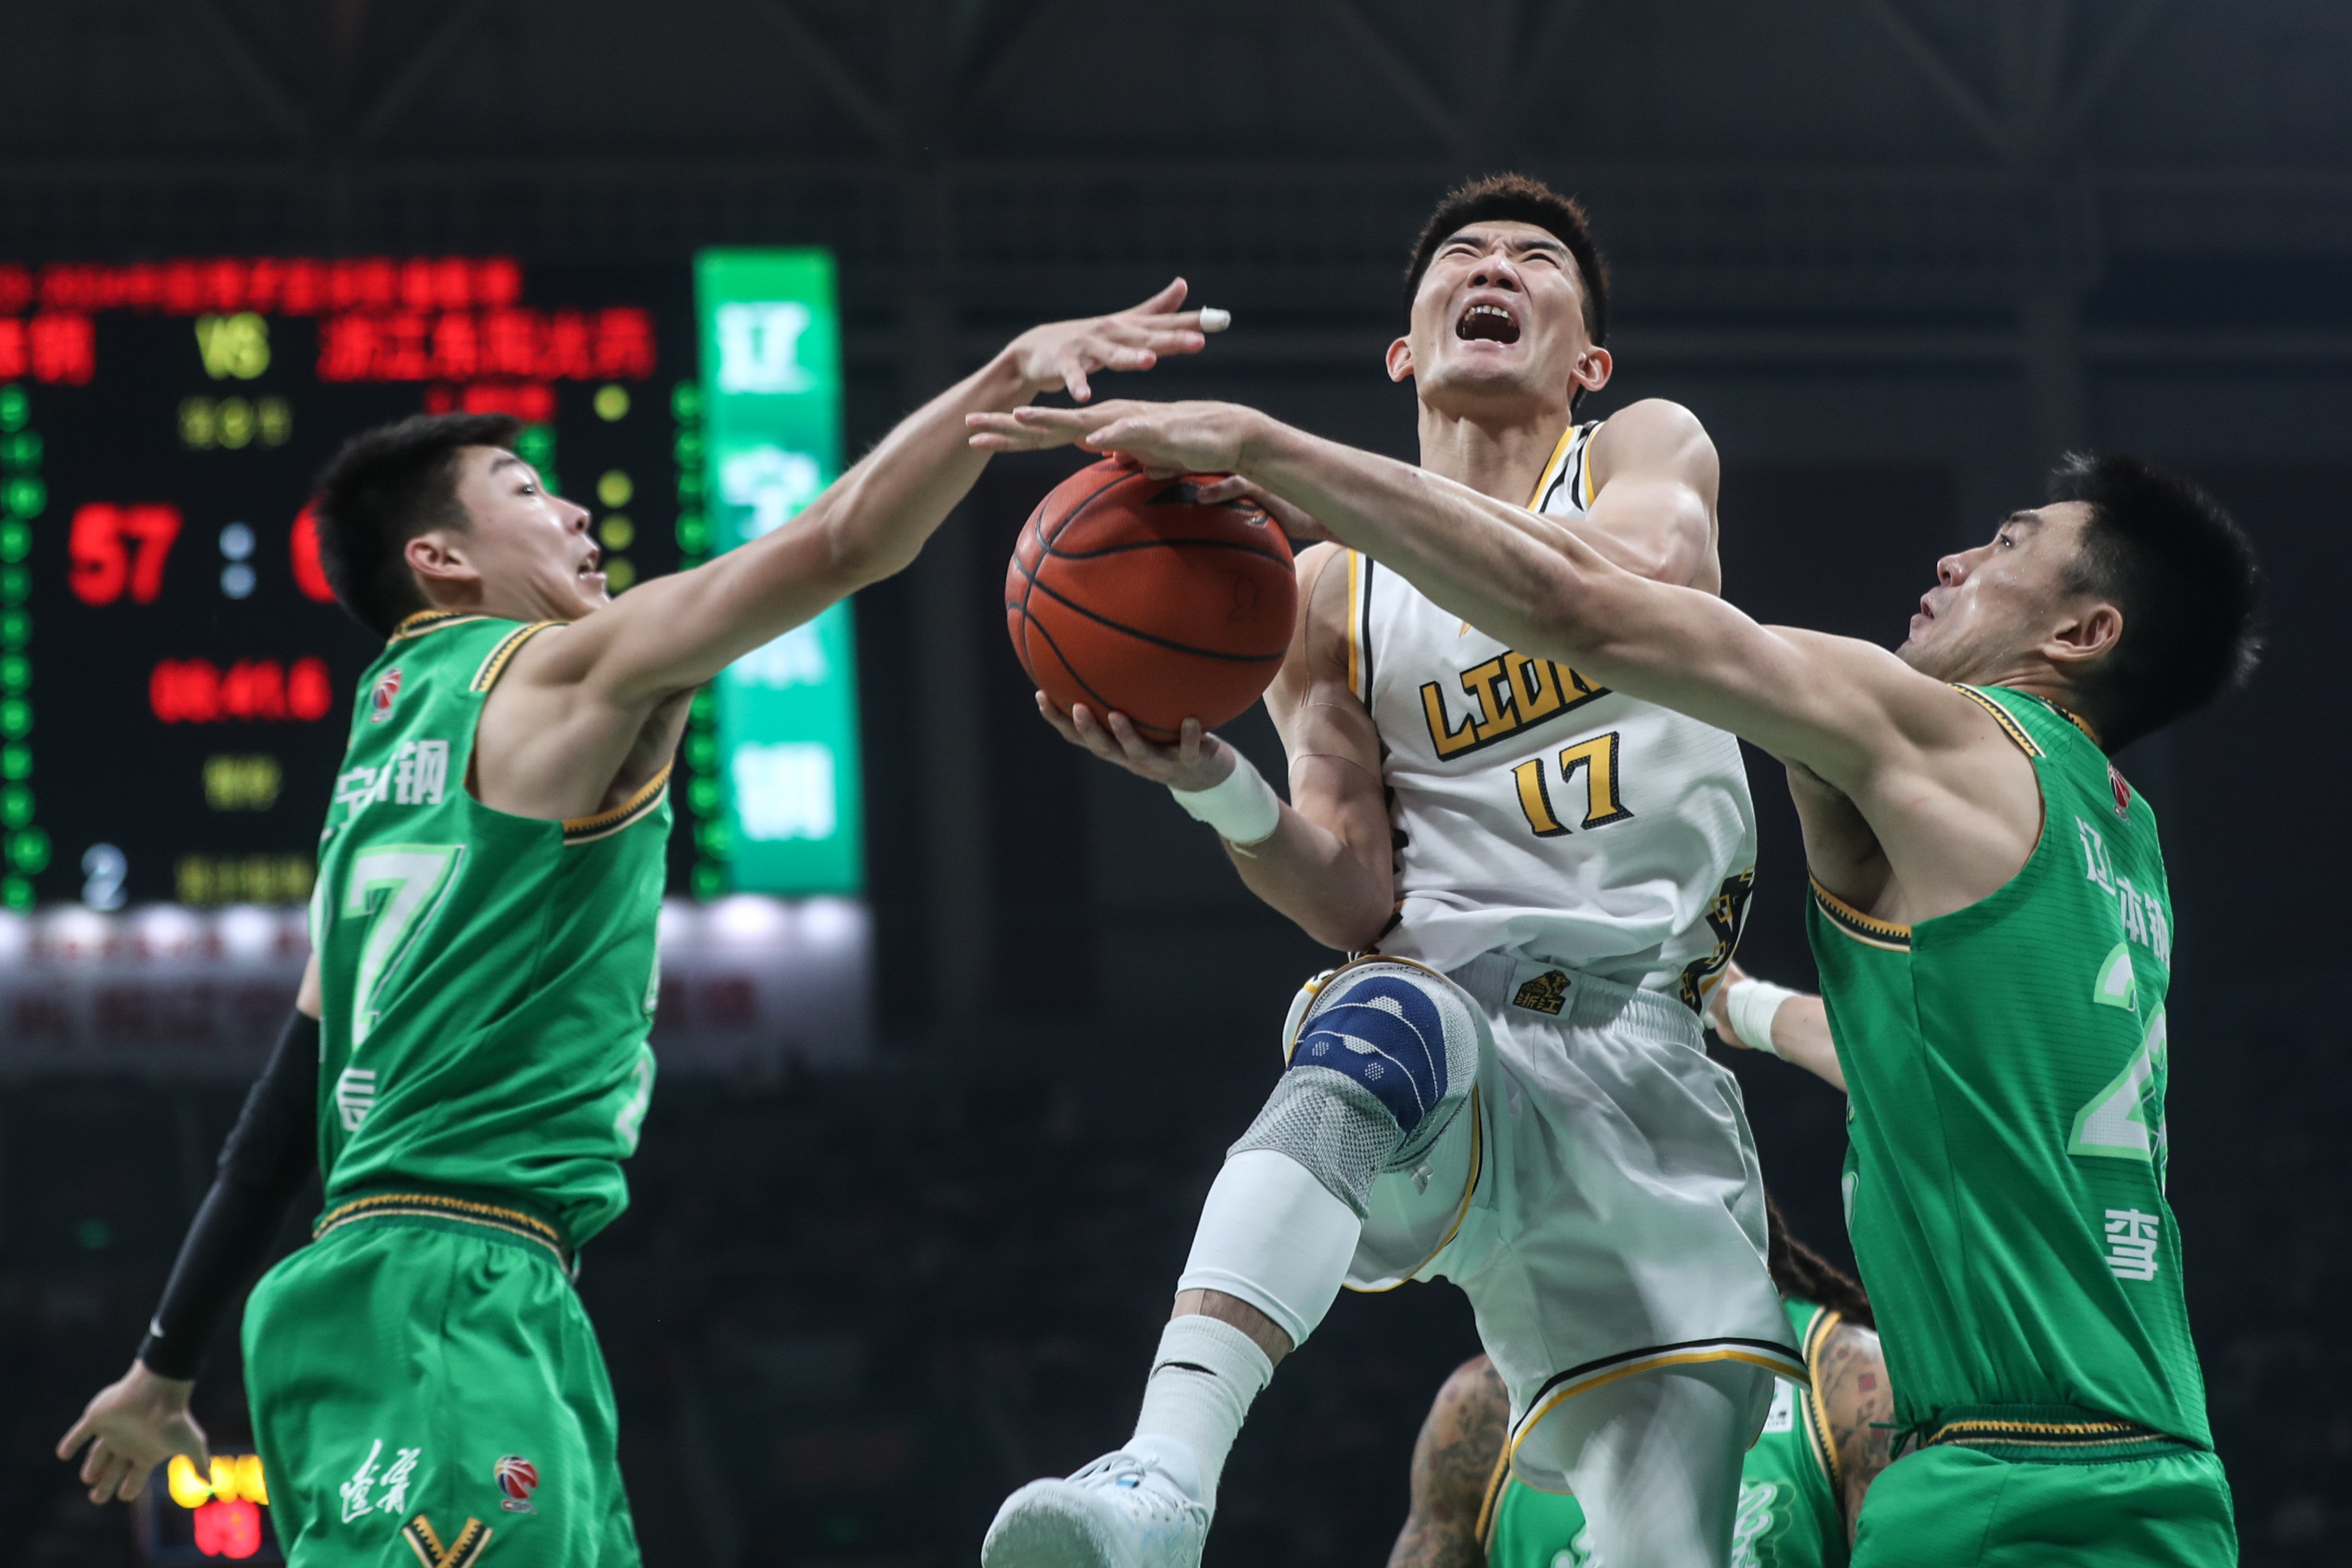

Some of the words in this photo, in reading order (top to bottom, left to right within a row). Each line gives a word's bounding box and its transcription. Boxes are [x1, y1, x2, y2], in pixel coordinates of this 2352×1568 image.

[68, 501, 184, 606] 57
[1510, 731, 1635, 838] 17
[1515, 992, 1562, 1014] 浙江
[2105, 1208, 2160, 1282] 李
